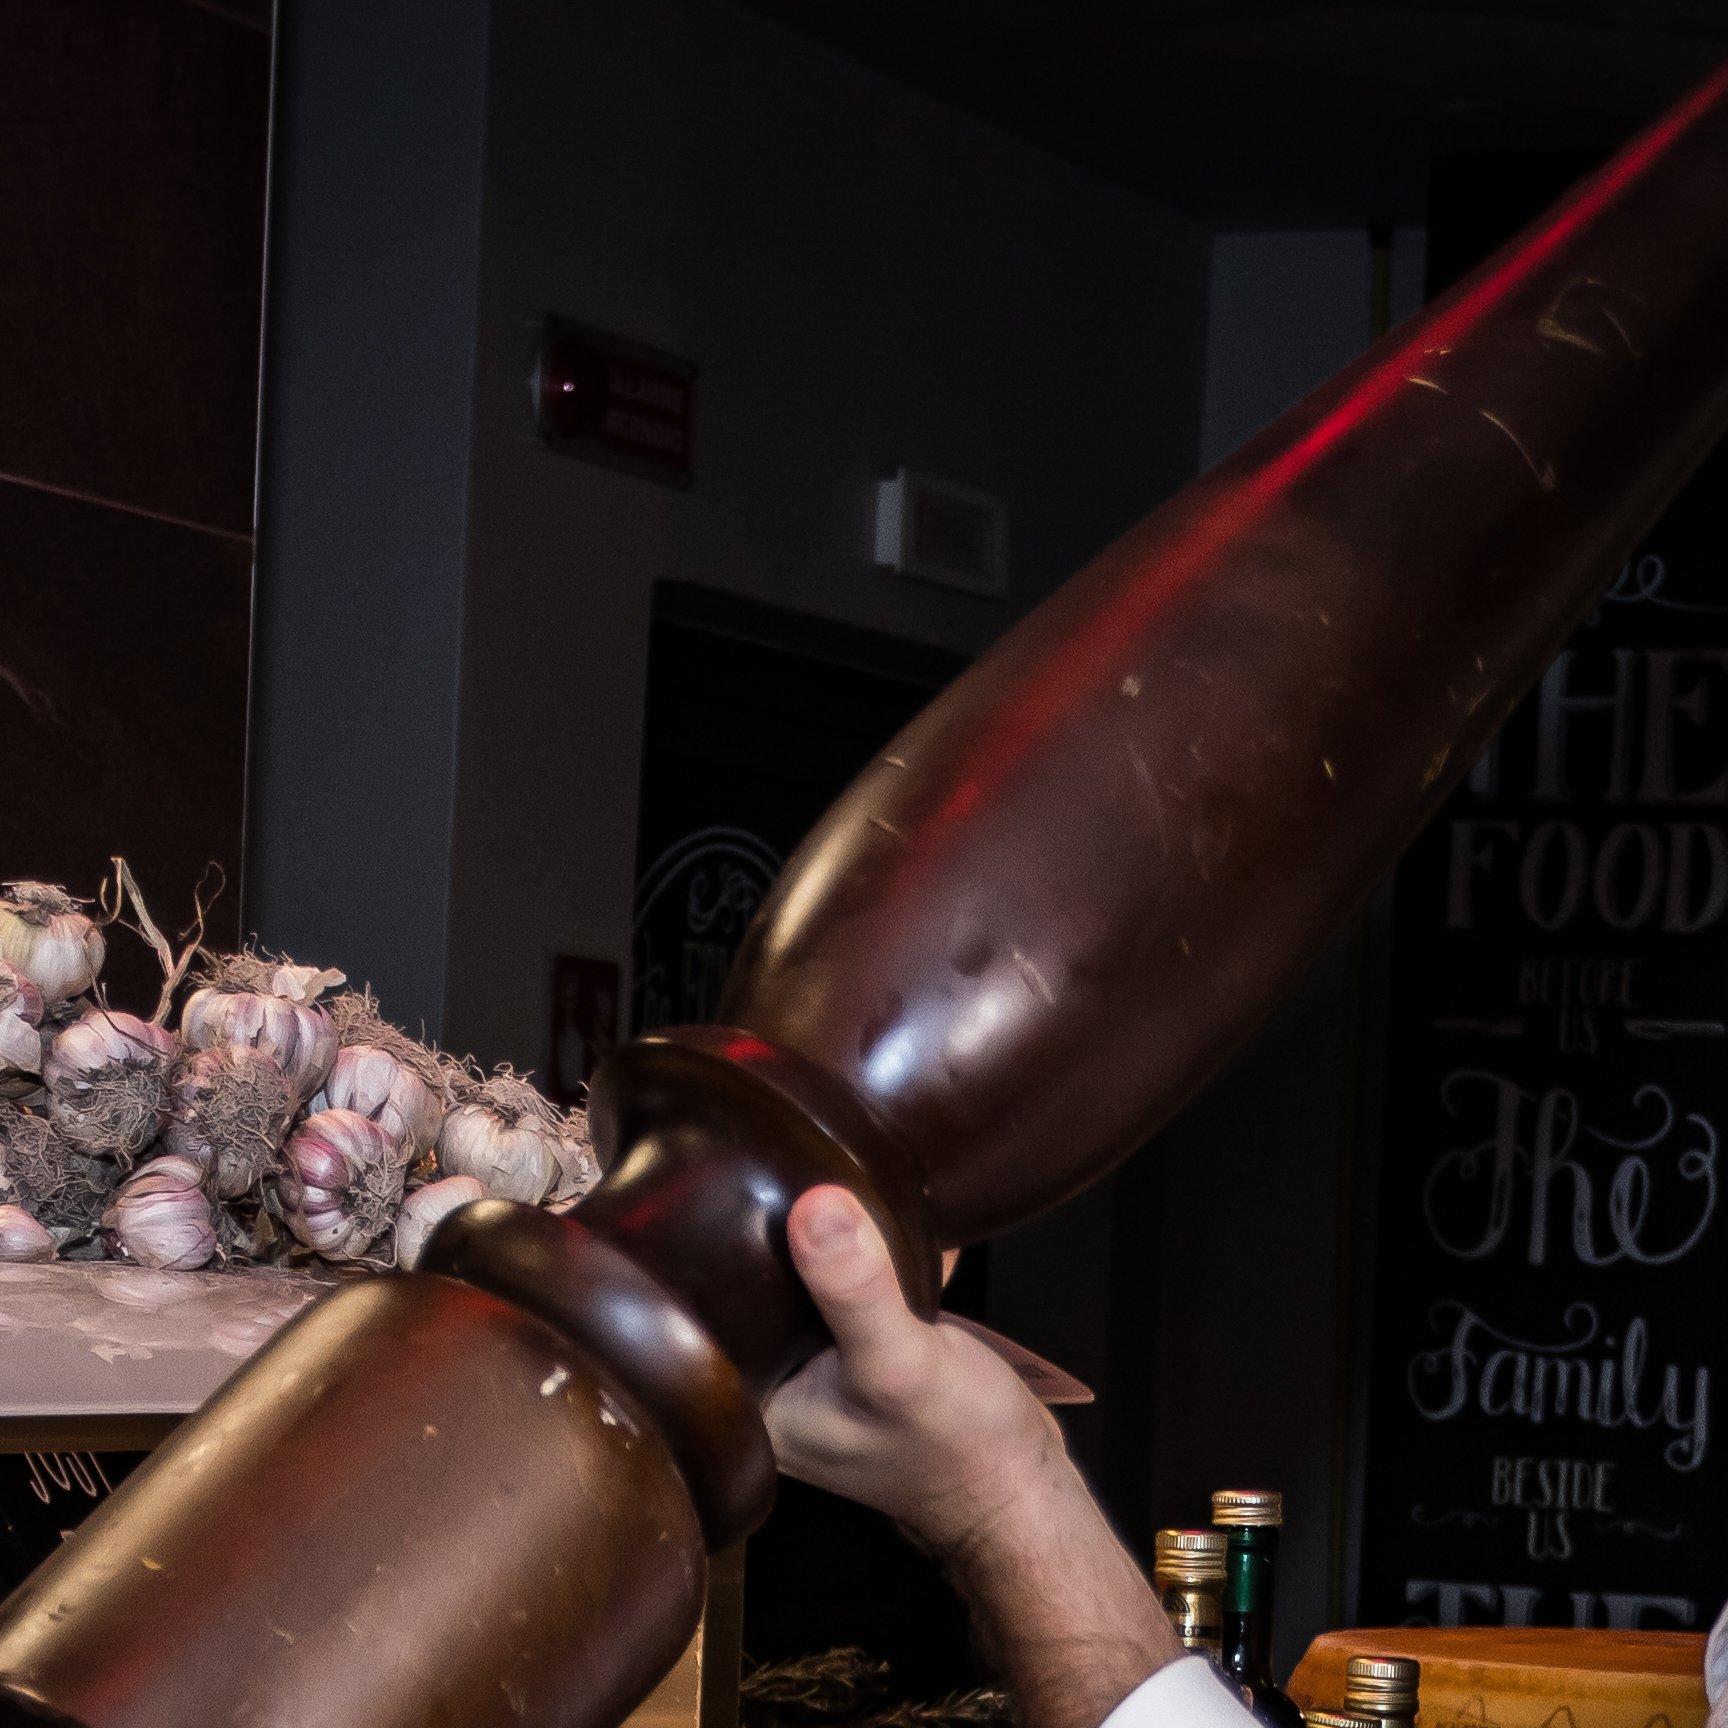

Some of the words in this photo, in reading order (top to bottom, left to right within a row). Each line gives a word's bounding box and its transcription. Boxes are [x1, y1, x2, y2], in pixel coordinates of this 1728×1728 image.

[1421, 1066, 1720, 1268] The
[1405, 1299, 1713, 1474] Family
[1489, 1455, 1618, 1513] BESIDE
[1526, 1510, 1574, 1562] US
